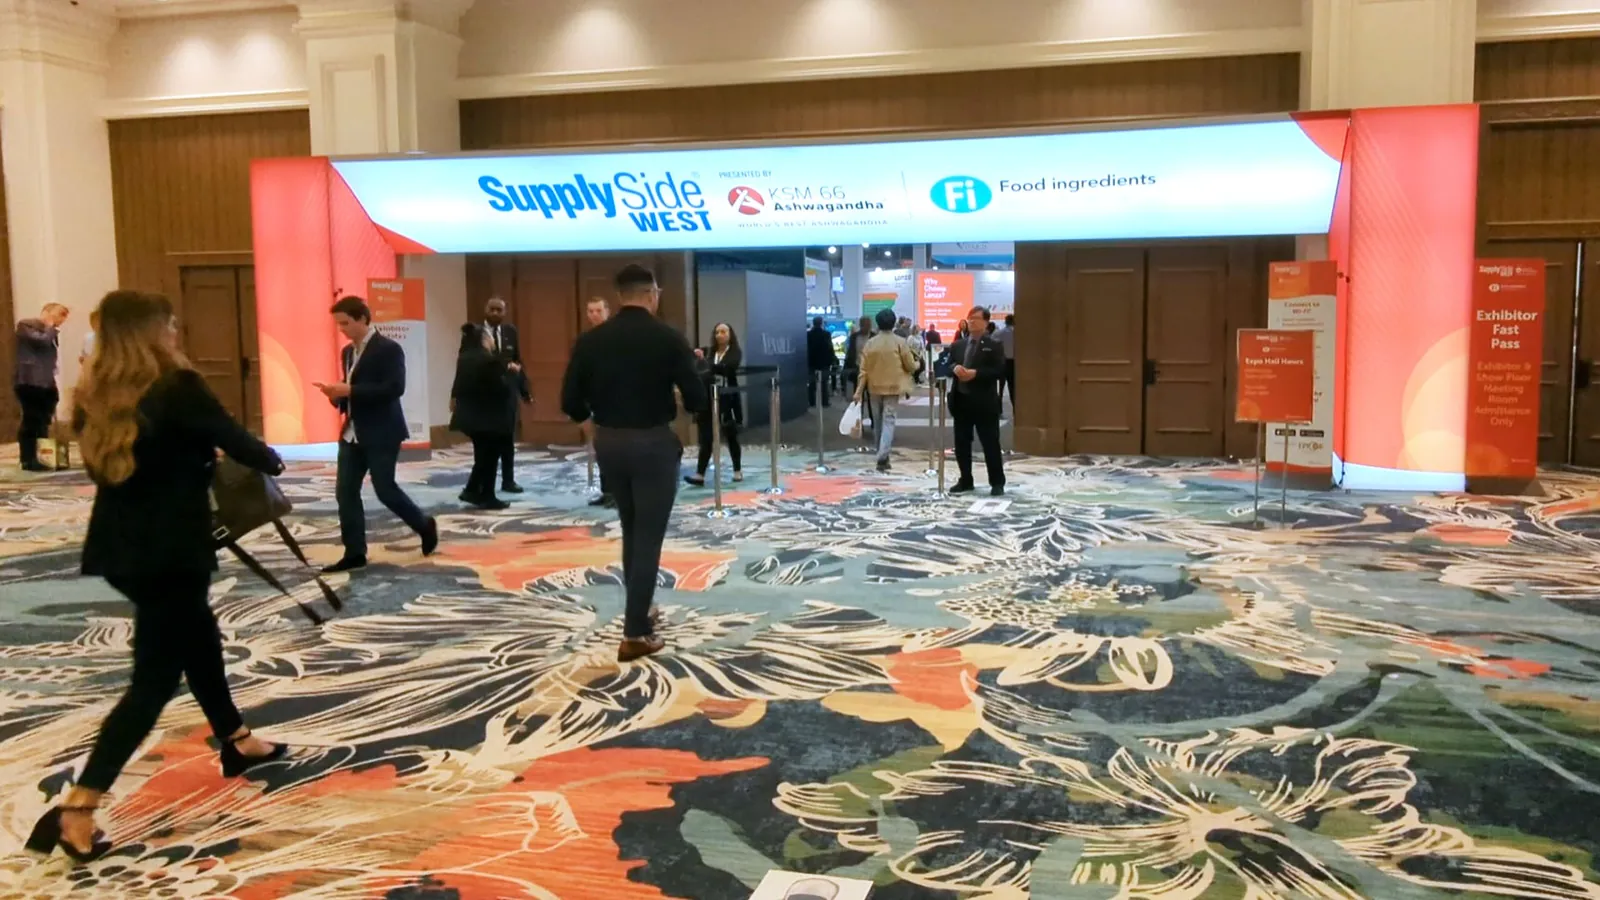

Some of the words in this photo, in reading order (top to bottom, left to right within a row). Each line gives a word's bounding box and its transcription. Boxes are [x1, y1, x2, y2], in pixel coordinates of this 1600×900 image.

[718, 171, 760, 179] PRESENTED
[762, 170, 772, 178] BY
[999, 177, 1046, 193] Food
[1052, 173, 1157, 193] ingredients
[478, 171, 705, 219] SupplySide
[768, 186, 813, 201] KSM
[819, 185, 846, 200] 66
[944, 180, 978, 211] Fi
[774, 200, 884, 213] Ashwagandha
[628, 210, 713, 232] WEST
[1476, 308, 1539, 322] Exhibitor
[1492, 323, 1520, 336] Fast
[1490, 337, 1521, 350] Pass
[1245, 357, 1263, 367] Expo
[1264, 357, 1280, 365] Hall
[1477, 360, 1521, 371] Exhibitor
[1505, 372, 1531, 382] Floor
[1483, 383, 1524, 395] Meeting
[1488, 394, 1518, 404] Room
[1474, 405, 1531, 416] Admittance
[1490, 416, 1515, 428] Only
